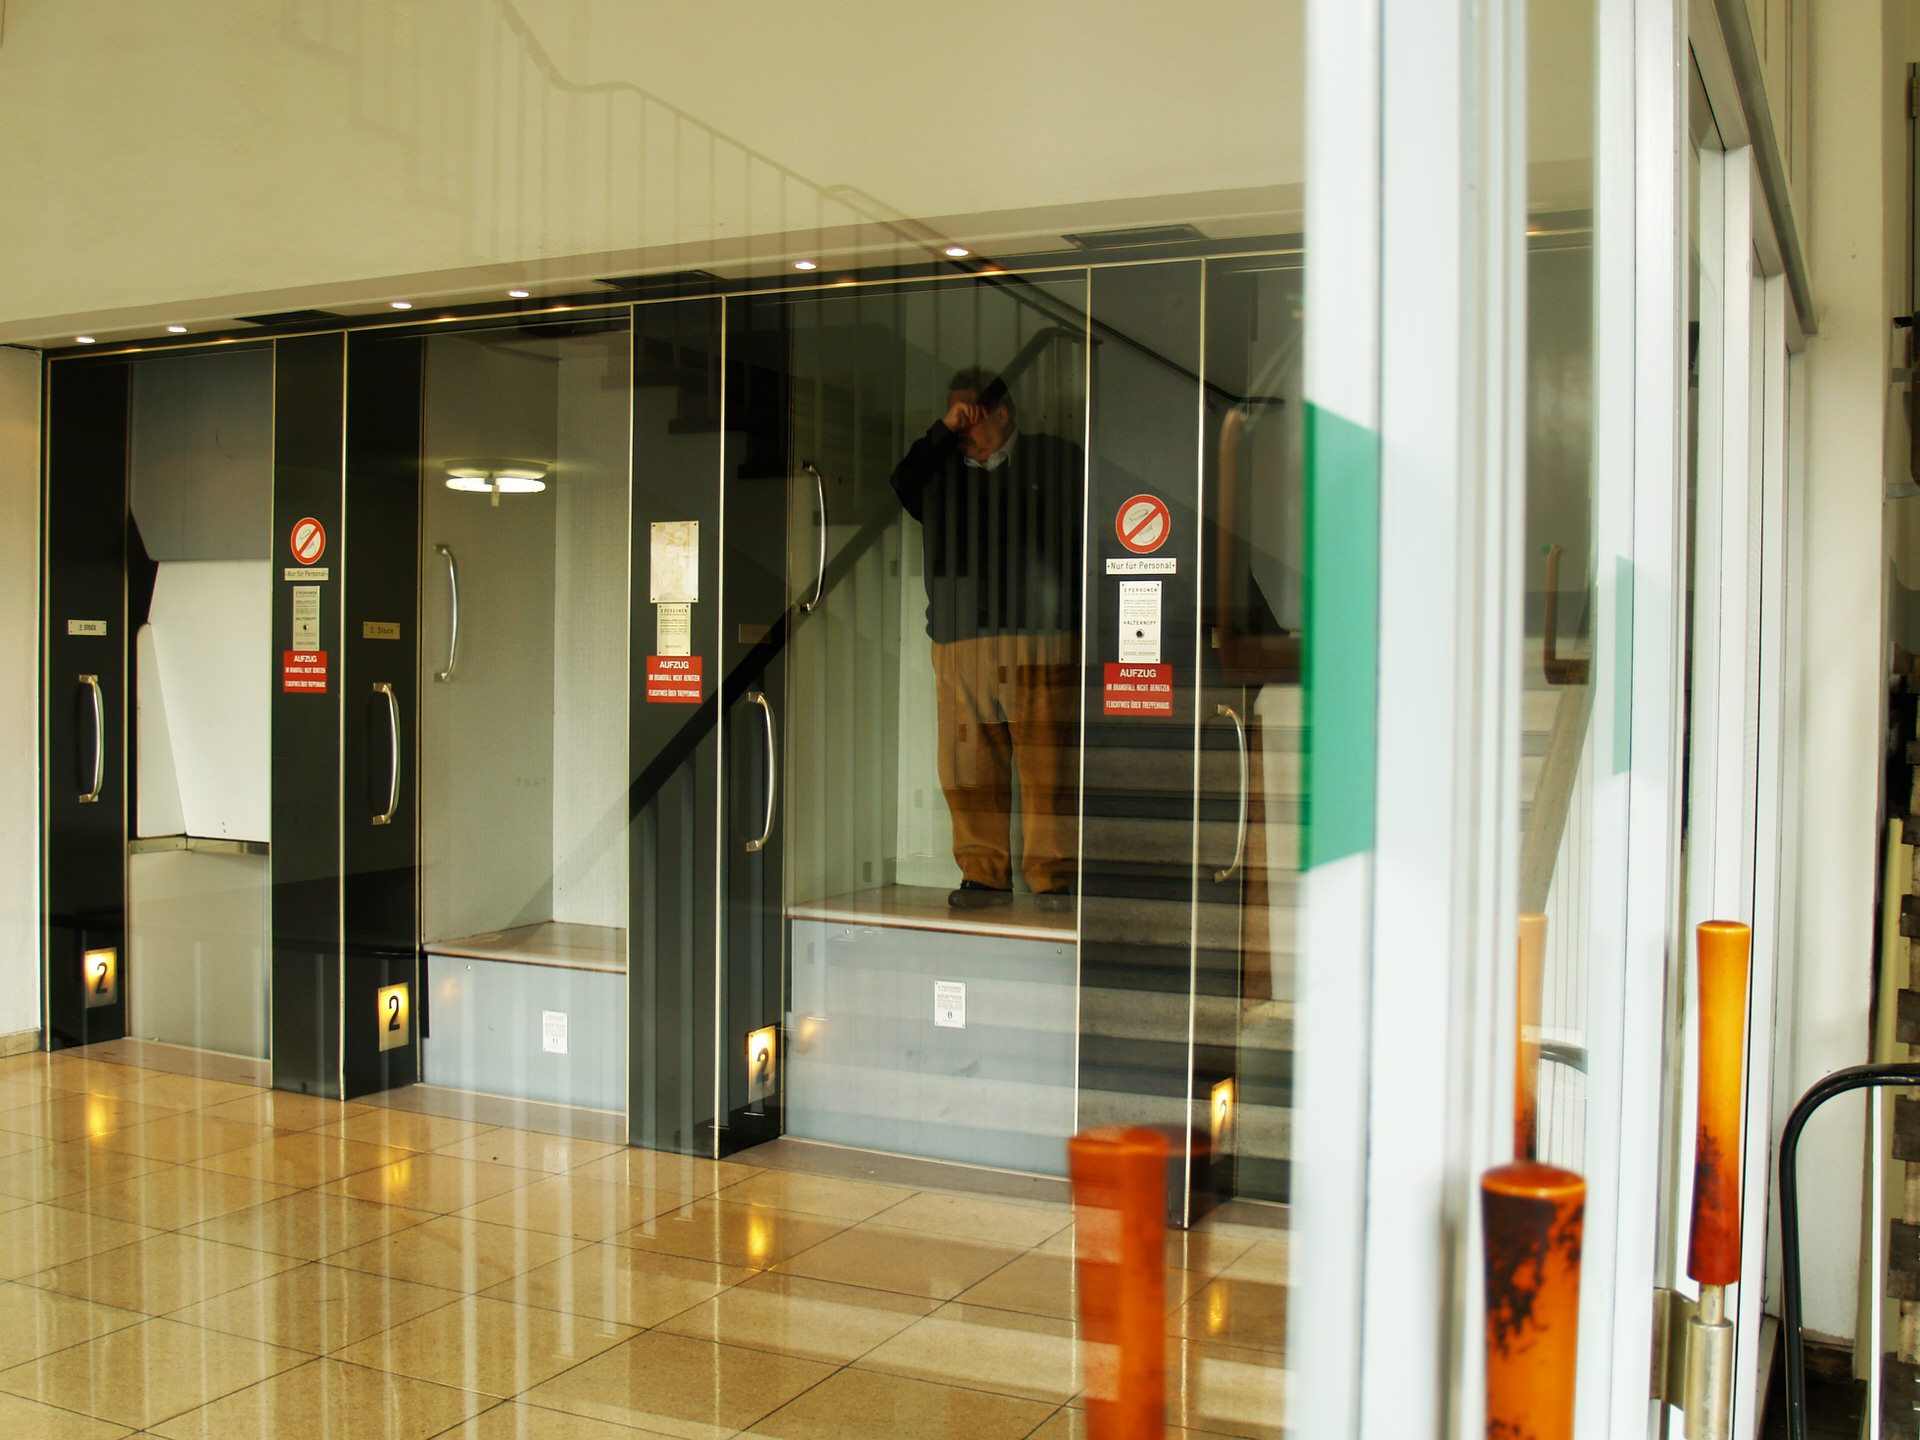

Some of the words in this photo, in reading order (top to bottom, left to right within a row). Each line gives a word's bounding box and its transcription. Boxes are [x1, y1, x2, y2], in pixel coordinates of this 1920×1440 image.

[1110, 562, 1124, 570] Nur
[1139, 561, 1172, 570] Personal
[294, 655, 318, 663] AUFZUG
[659, 660, 689, 669] AUFZUG
[1119, 668, 1157, 678] AUFZUG
[96, 961, 108, 994] 2
[388, 995, 400, 1032] 2
[756, 1047, 770, 1085] 2
